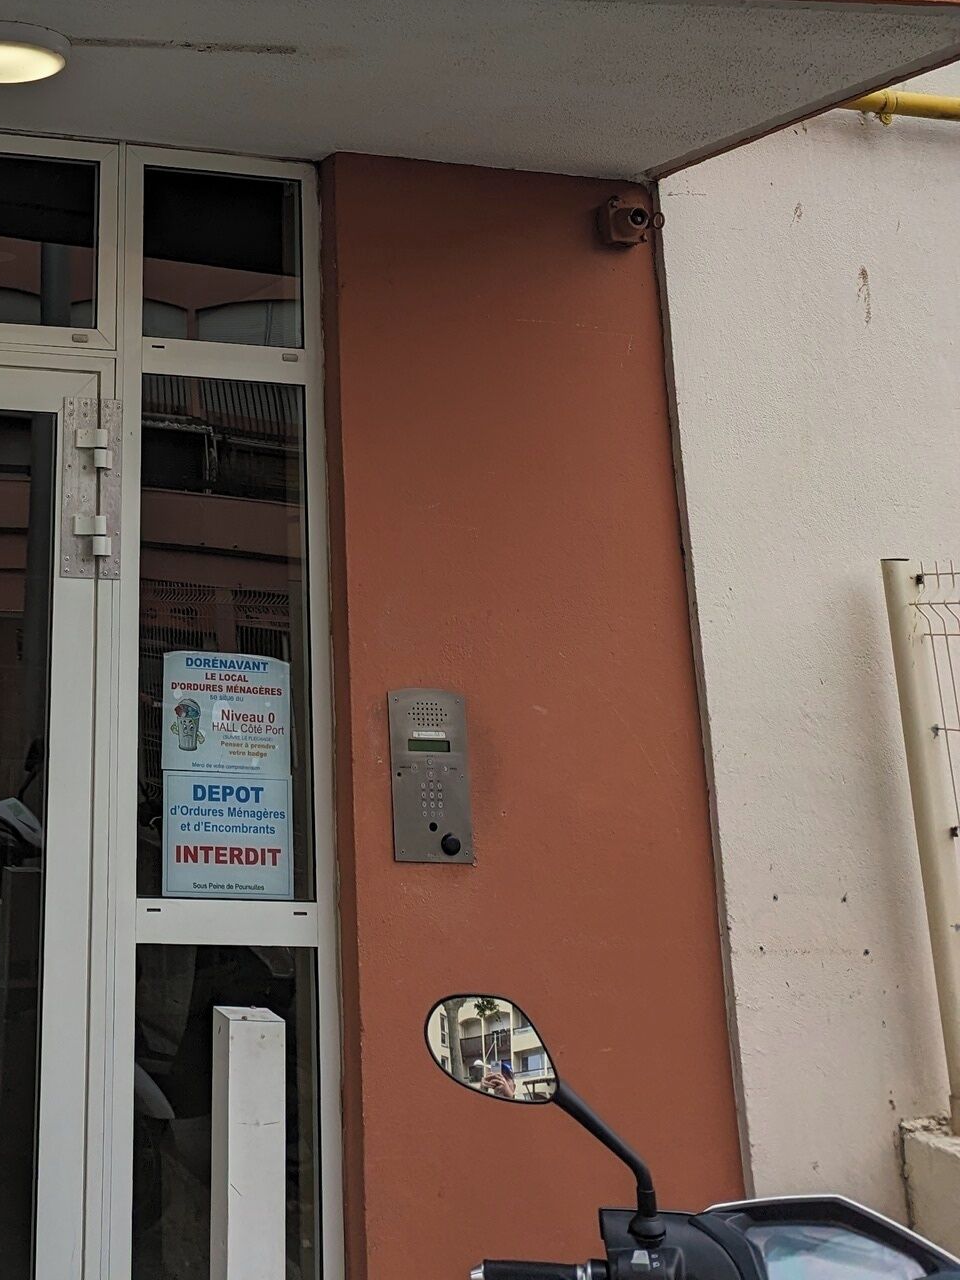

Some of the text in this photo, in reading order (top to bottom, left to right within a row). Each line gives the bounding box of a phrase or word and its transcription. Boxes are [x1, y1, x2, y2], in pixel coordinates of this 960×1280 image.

[186, 657, 268, 671] DORÉNAVANT
[219, 674, 248, 682] LOCAL
[171, 682, 282, 696] D'ORDURES MÉNAGÈRES
[221, 709, 275, 723] Niveau 0
[212, 722, 284, 735] HALL Côté Port
[193, 784, 264, 803] DEPOT
[170, 805, 286, 820] d'Ordures Ménagères
[180, 821, 276, 835] et d'Encombrants
[176, 845, 281, 866] INTERDIT
